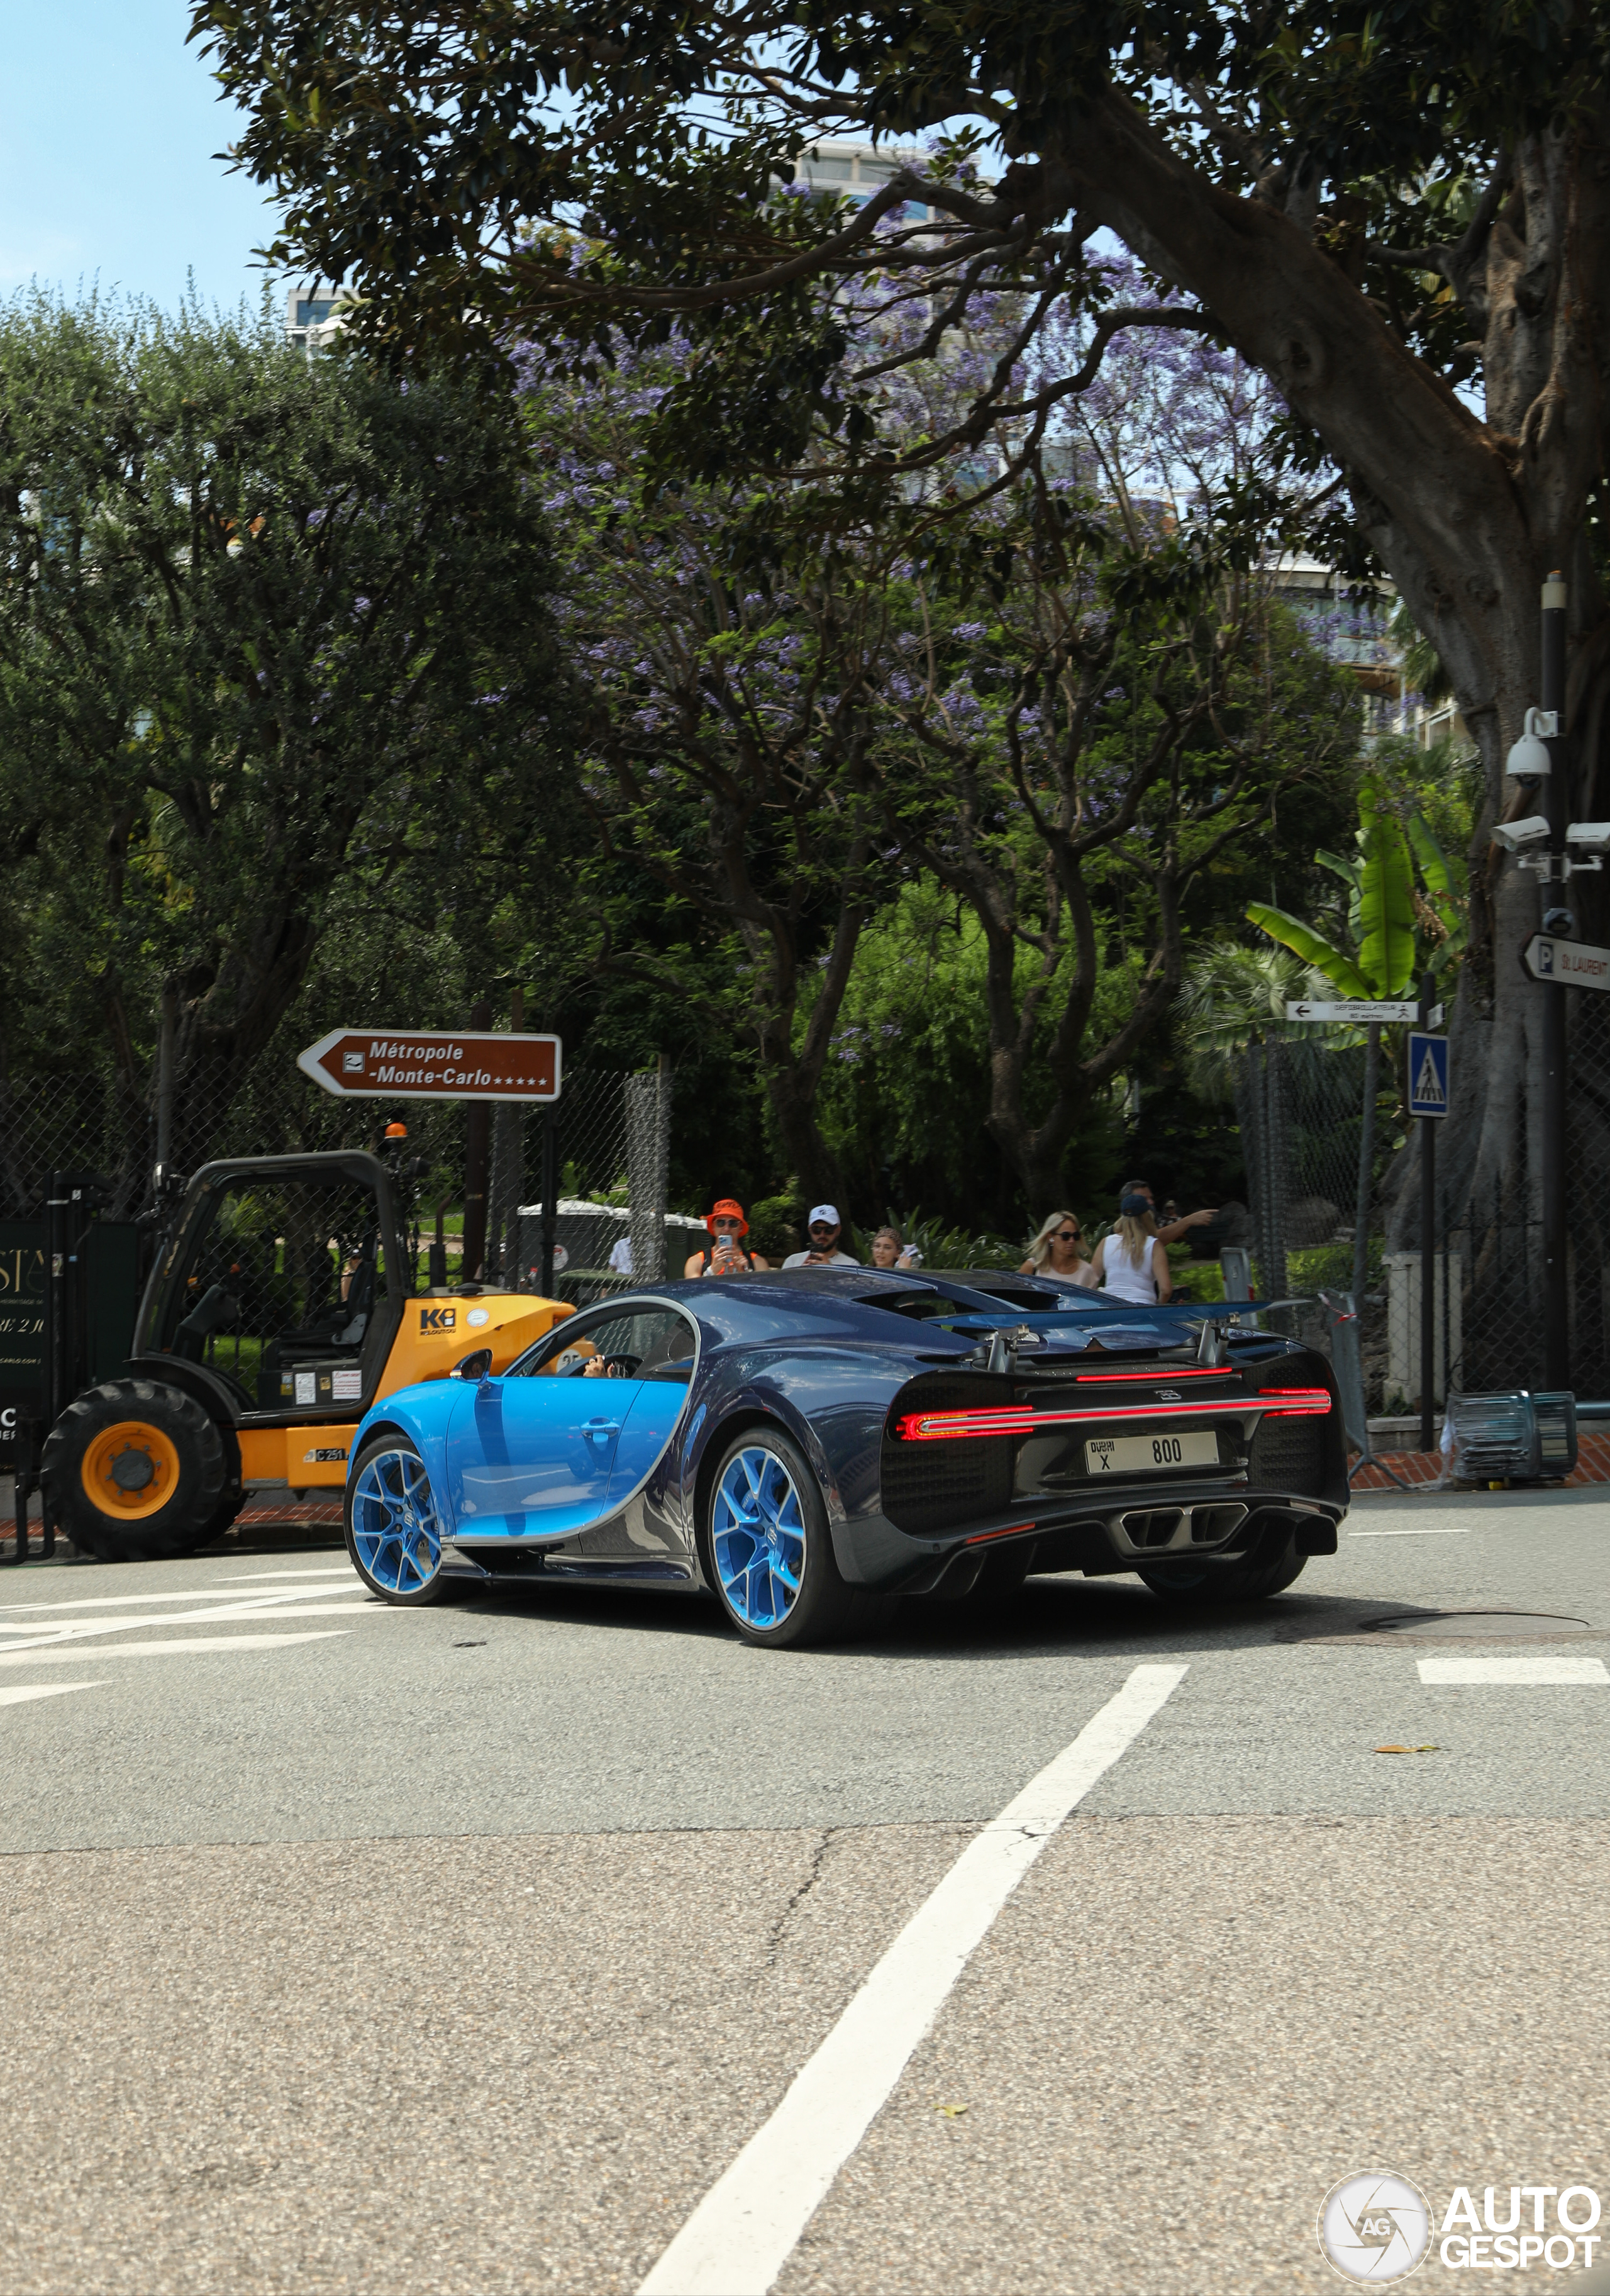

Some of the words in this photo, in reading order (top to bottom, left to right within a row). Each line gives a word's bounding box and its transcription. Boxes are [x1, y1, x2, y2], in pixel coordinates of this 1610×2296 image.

[1572, 956, 1608, 977] LAURENT
[369, 1041, 464, 1063] Métropole
[17, 1318, 30, 1333] 2
[326, 1449, 343, 1461] 251
[1152, 1438, 1182, 1464] 800
[1099, 1454, 1110, 1470] X
